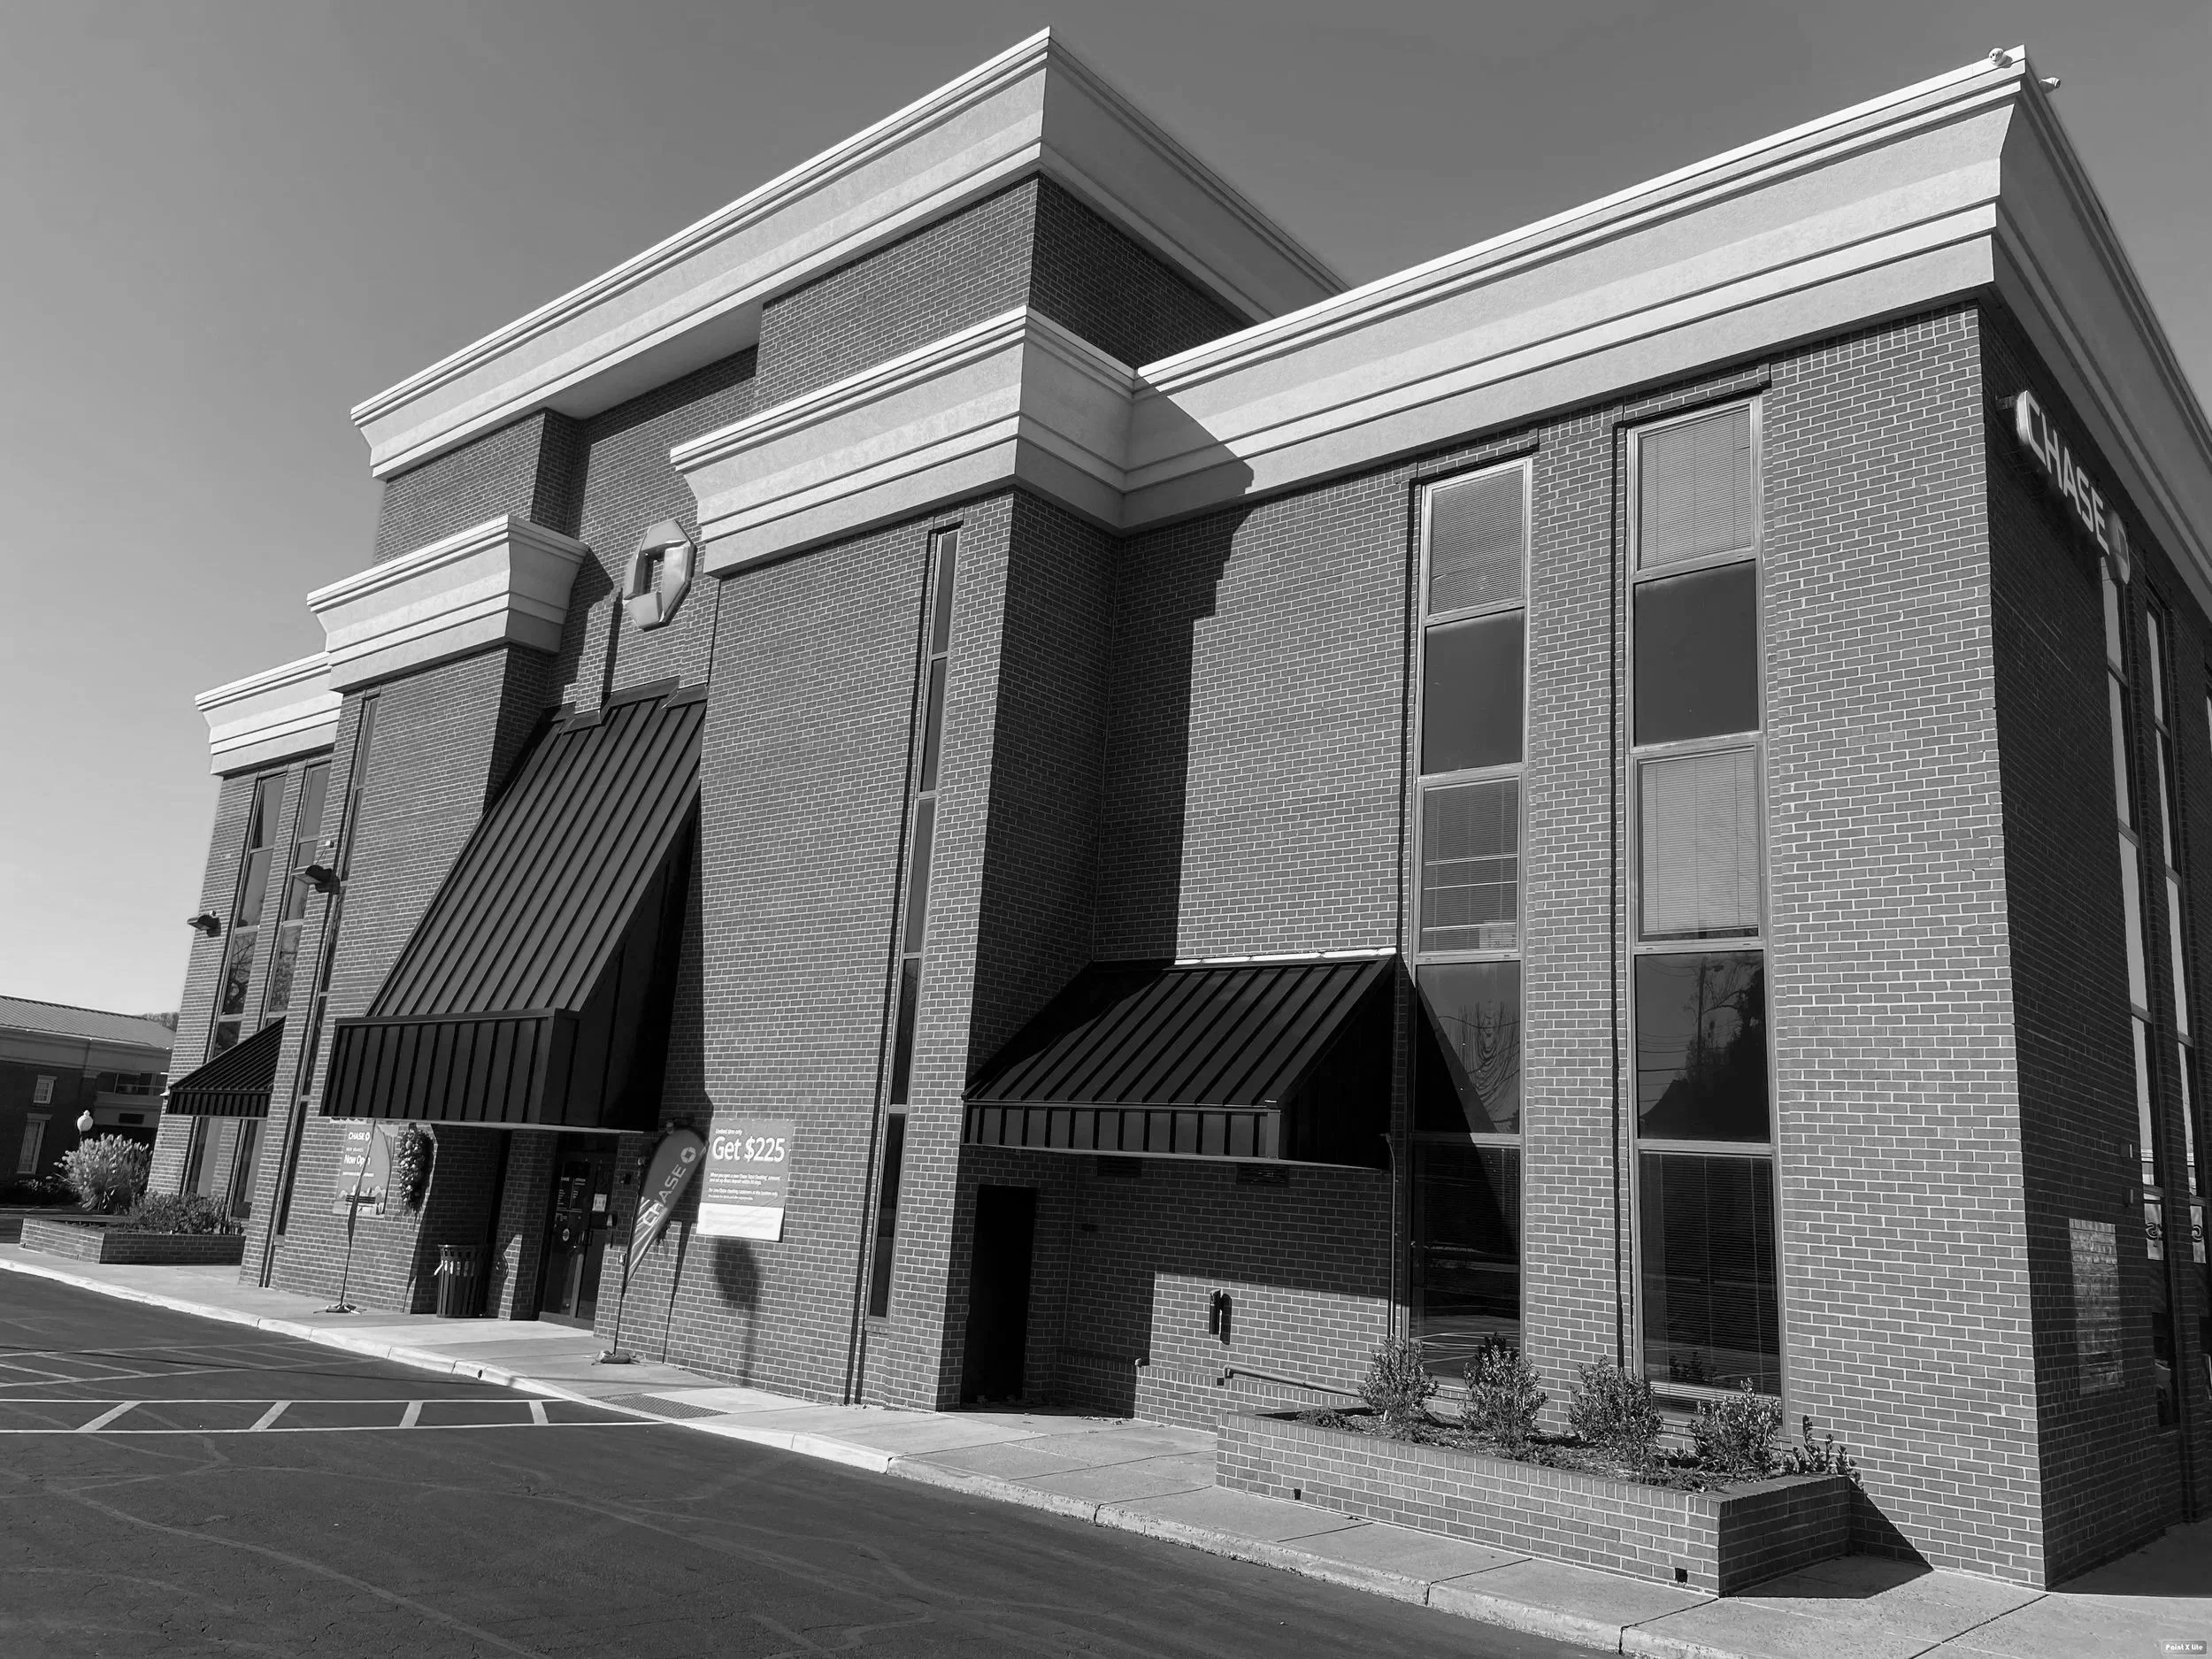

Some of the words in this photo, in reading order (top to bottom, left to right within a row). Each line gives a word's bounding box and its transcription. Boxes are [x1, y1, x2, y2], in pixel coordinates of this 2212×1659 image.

[2016, 390, 2109, 556] CHASE
[348, 1132, 365, 1141] CHASE
[712, 1136, 742, 1161] Get
[743, 1136, 786, 1163] $225
[344, 1154, 357, 1164] Now
[357, 1155, 371, 1168] Opn
[643, 1164, 687, 1226] CHASE
